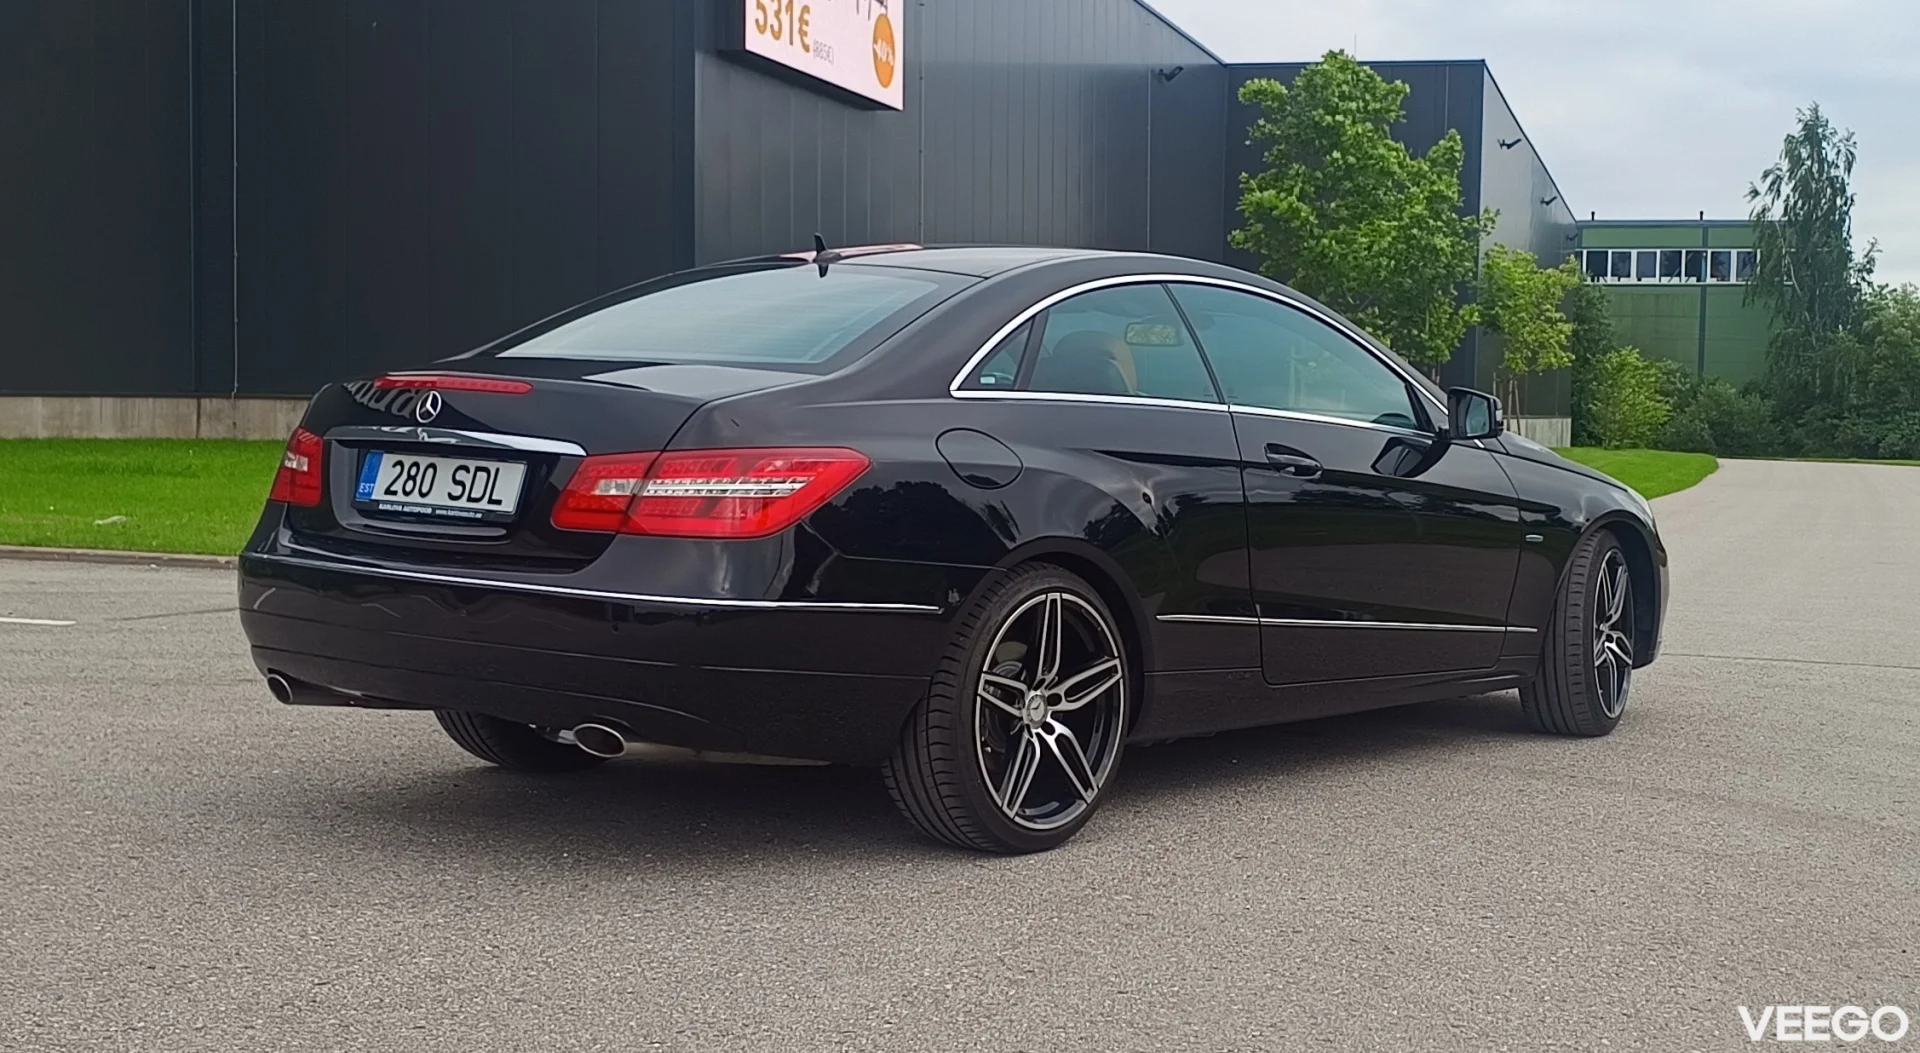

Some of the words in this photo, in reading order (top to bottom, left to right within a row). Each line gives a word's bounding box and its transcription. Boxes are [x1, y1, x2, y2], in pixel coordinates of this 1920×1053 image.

[359, 482, 374, 493] EST
[384, 460, 437, 498] 280
[447, 464, 503, 506] SDL
